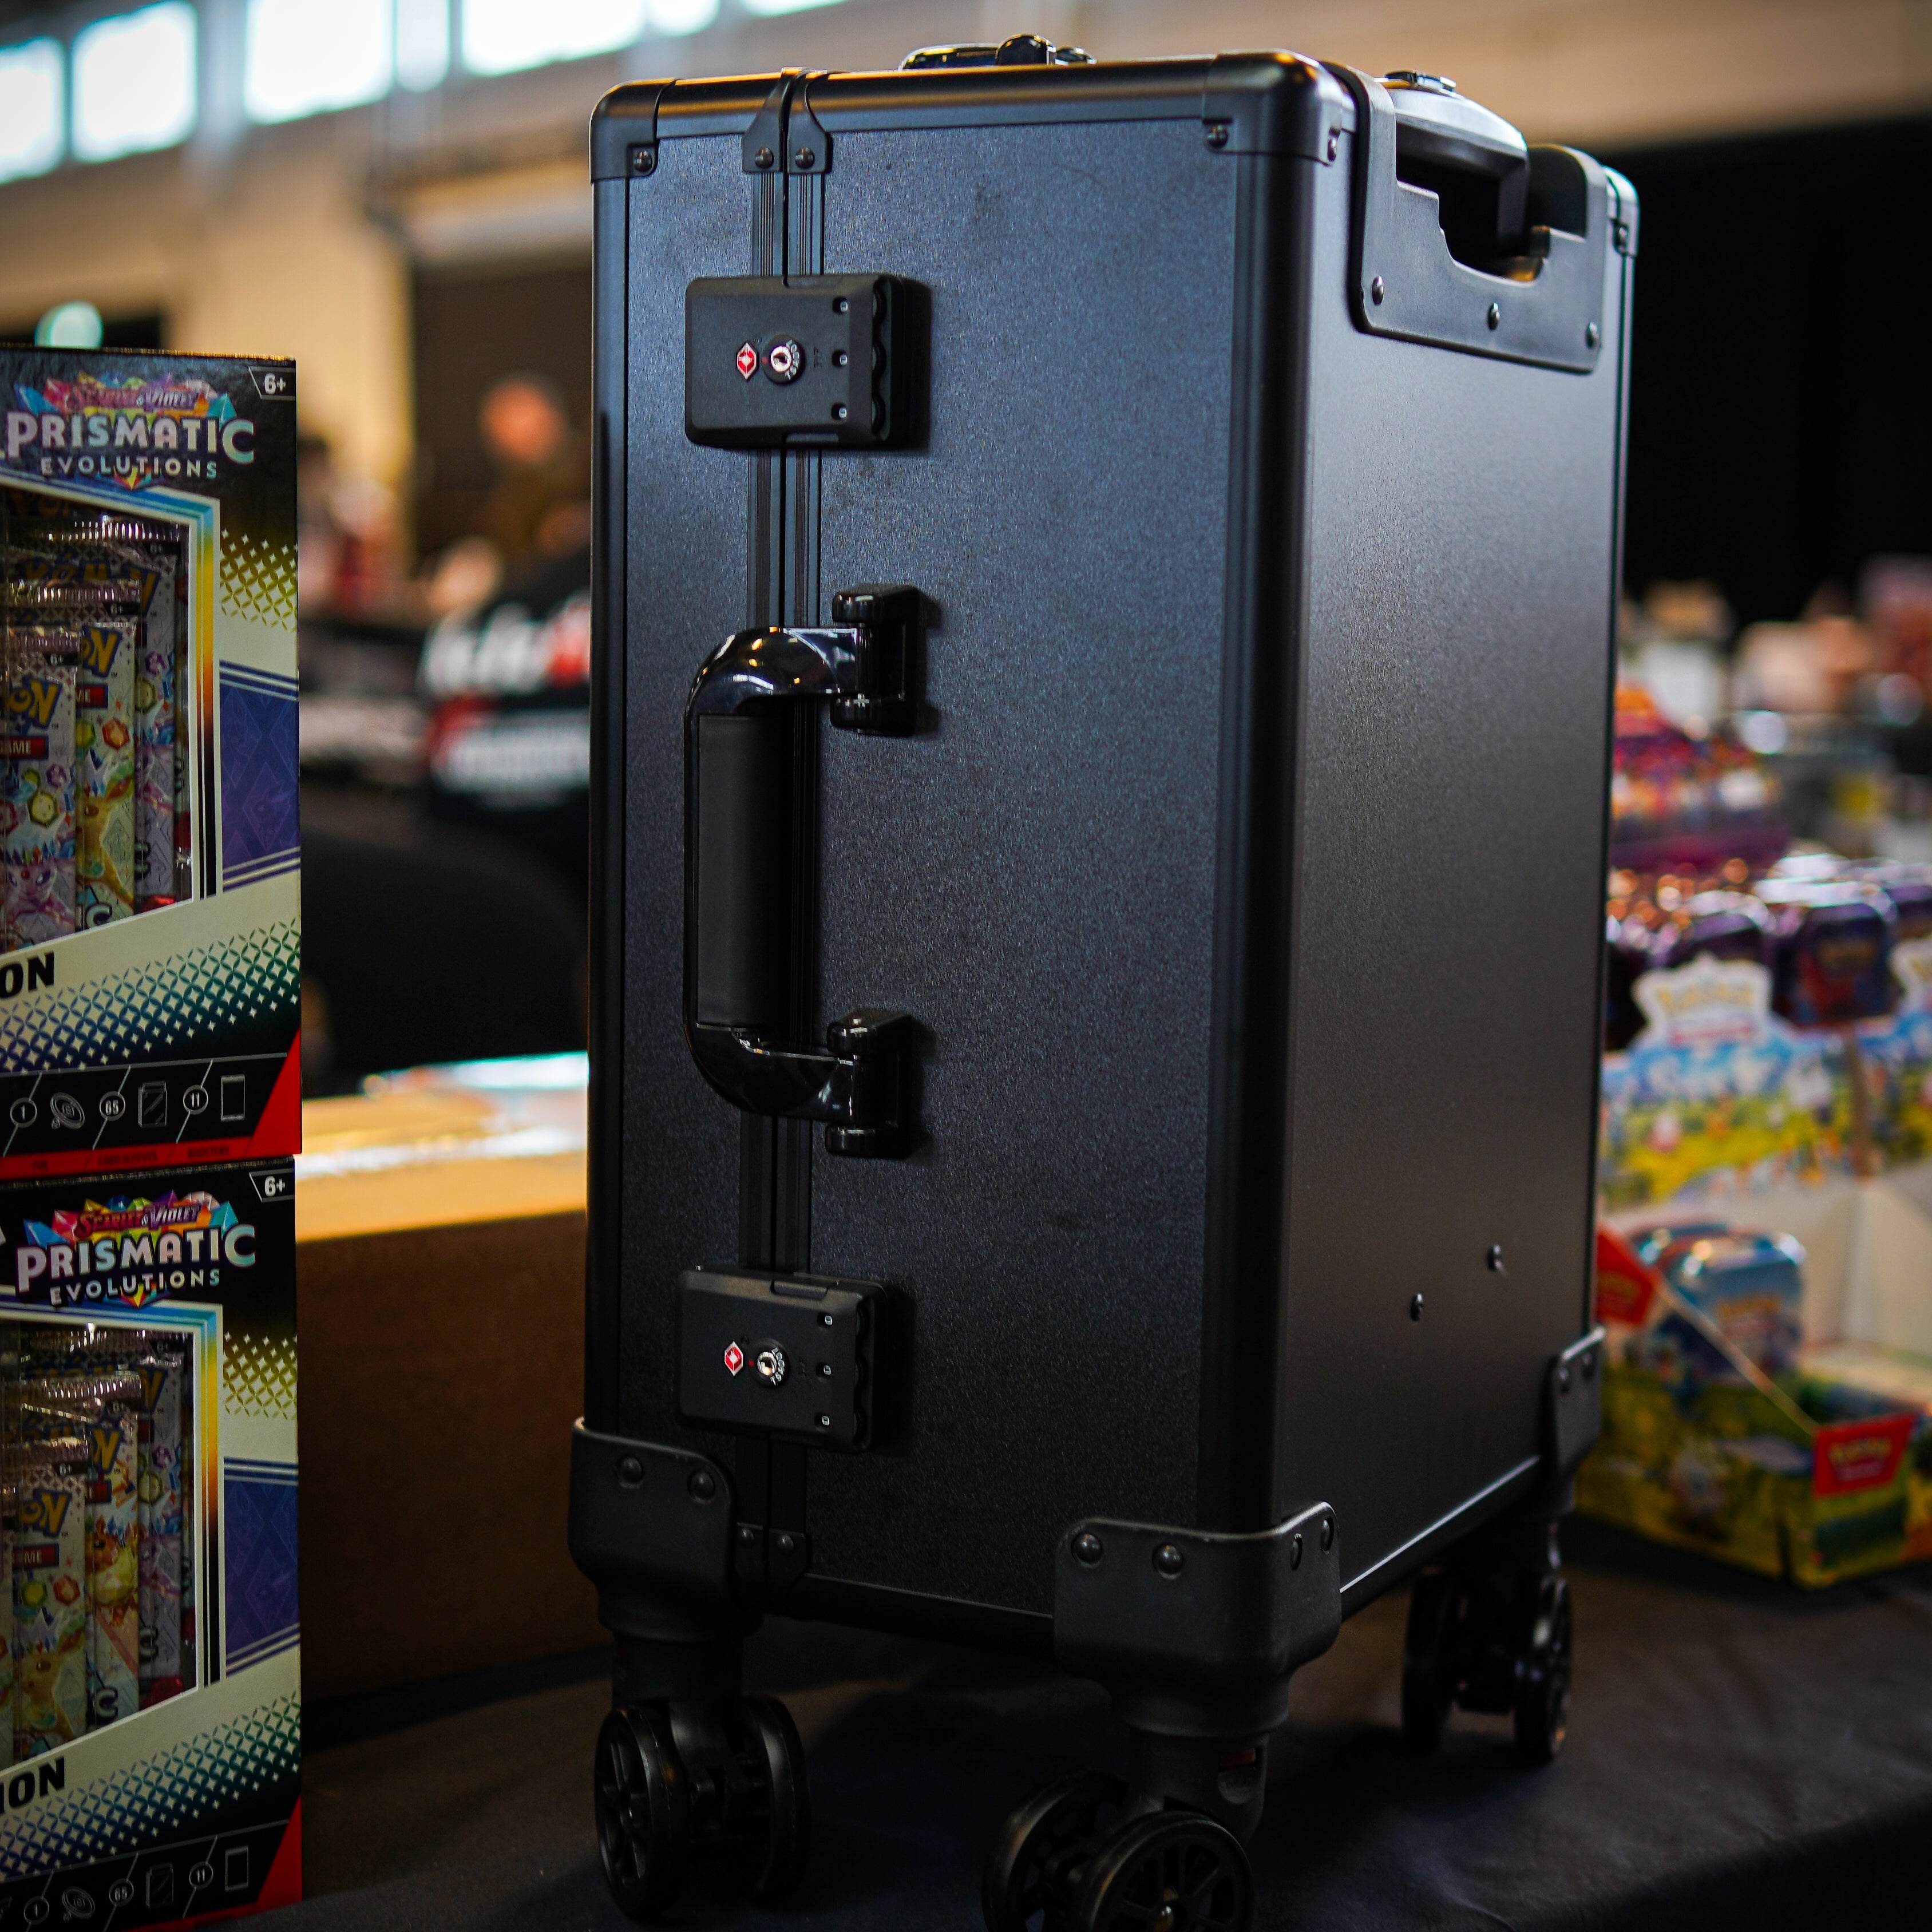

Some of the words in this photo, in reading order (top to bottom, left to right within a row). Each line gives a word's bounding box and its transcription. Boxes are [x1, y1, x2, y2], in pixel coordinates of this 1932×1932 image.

[264, 373, 286, 394] 6+
[7, 411, 254, 464] PRISMATIC
[41, 456, 217, 478] EVOLUTIONS
[264, 1176, 286, 1197] 6+
[16, 1224, 255, 1293] PRISMATIC
[50, 1269, 220, 1305] EVOLUTIONS
